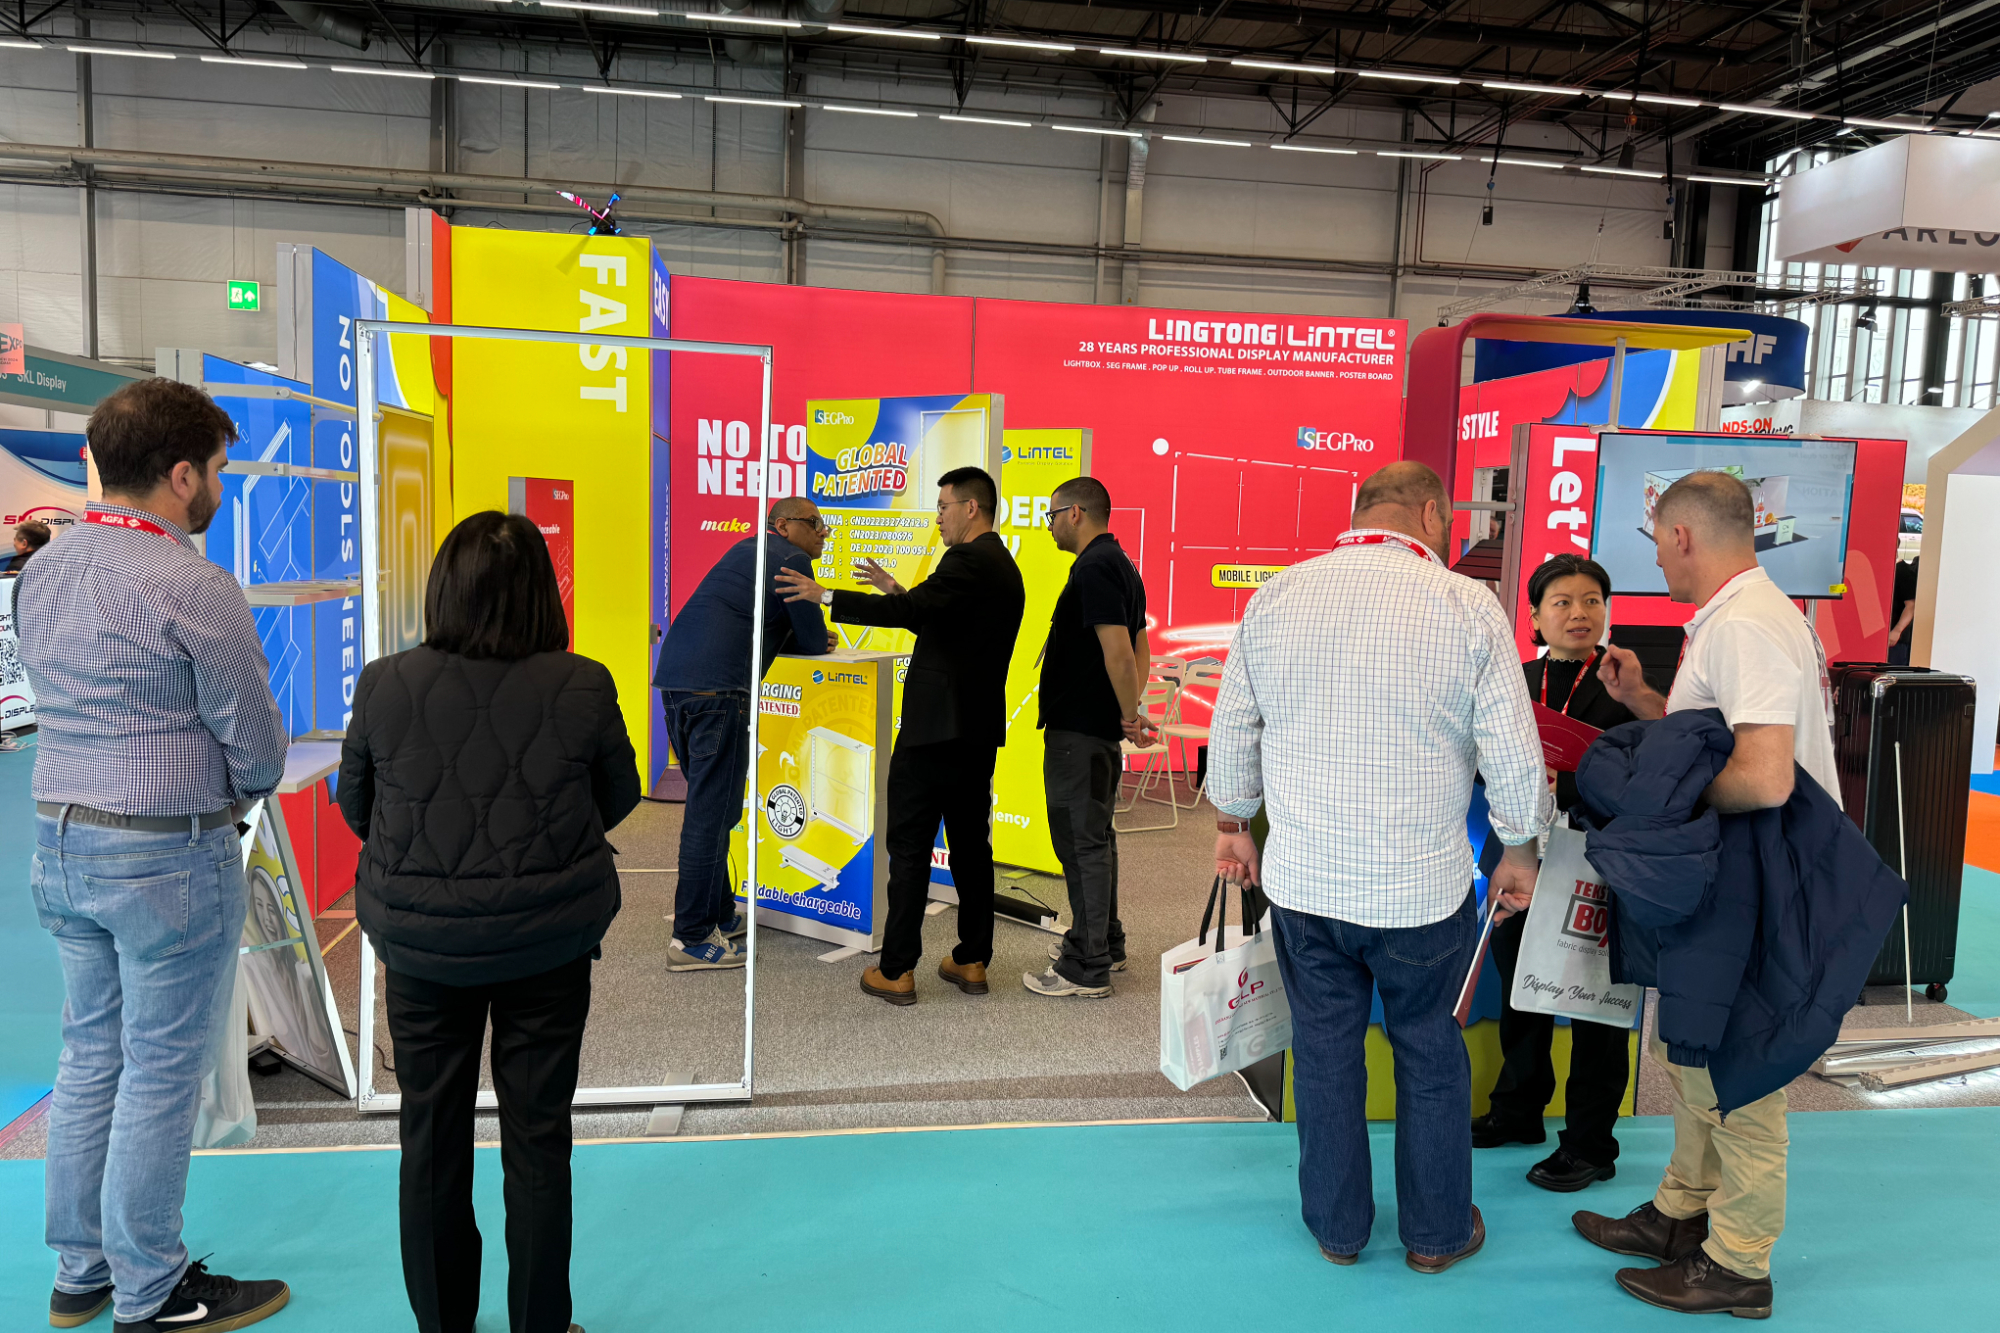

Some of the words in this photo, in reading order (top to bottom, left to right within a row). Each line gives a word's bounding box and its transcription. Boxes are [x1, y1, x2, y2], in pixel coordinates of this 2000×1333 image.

[653, 268, 670, 331] EASY
[579, 253, 628, 413] FAST
[339, 314, 351, 392] NO
[1078, 341, 1095, 352] 28
[1098, 342, 1138, 355] YEARS
[1140, 344, 1235, 359] PROFESSIONAL
[1237, 349, 1290, 362] DISPLAY
[1292, 350, 1394, 365] MANUFACTURER
[1063, 359, 1101, 368] LIGHTBOX
[1106, 361, 1120, 369] SEG
[1122, 362, 1147, 371] FRAME
[1218, 367, 1236, 375] TUBE
[1237, 368, 1262, 376] FRAME
[1267, 369, 1304, 378] OUTDOOR
[1305, 370, 1335, 379] BANNER
[1339, 371, 1367, 380] POSTER
[1368, 373, 1393, 381] BOARD
[36, 371, 67, 393] Display
[1462, 410, 1500, 441] STYLE
[1719, 417, 1773, 433] NDS-ON
[698, 418, 750, 458] NO
[835, 441, 908, 472] GLOBAL
[812, 467, 908, 498] PATENTED
[1544, 436, 1597, 562] Let'
[101, 514, 124, 525] AGFA
[700, 517, 751, 533] make
[821, 554, 834, 565] EU
[850, 543, 861, 553] DE
[862, 544, 873, 553] 20
[873, 545, 894, 554] 2023
[896, 545, 911, 555] 100
[912, 547, 936, 556] 051.7
[817, 566, 835, 578] USA
[1219, 569, 1251, 582] MOBILE
[1254, 571, 1279, 583] LIGH
[760, 682, 802, 700] RGING
[771, 818, 793, 834] LIGHT
[992, 810, 1030, 829] ency
[741, 880, 791, 903] Fdable
[791, 891, 861, 919] Chargeable
[1573, 879, 1609, 900] TEKS
[1556, 938, 1577, 951] fabric
[1578, 945, 1597, 958] display
[1522, 974, 1564, 999] Display
[1568, 985, 1596, 1001] Your
[1599, 991, 1632, 1010] Success
